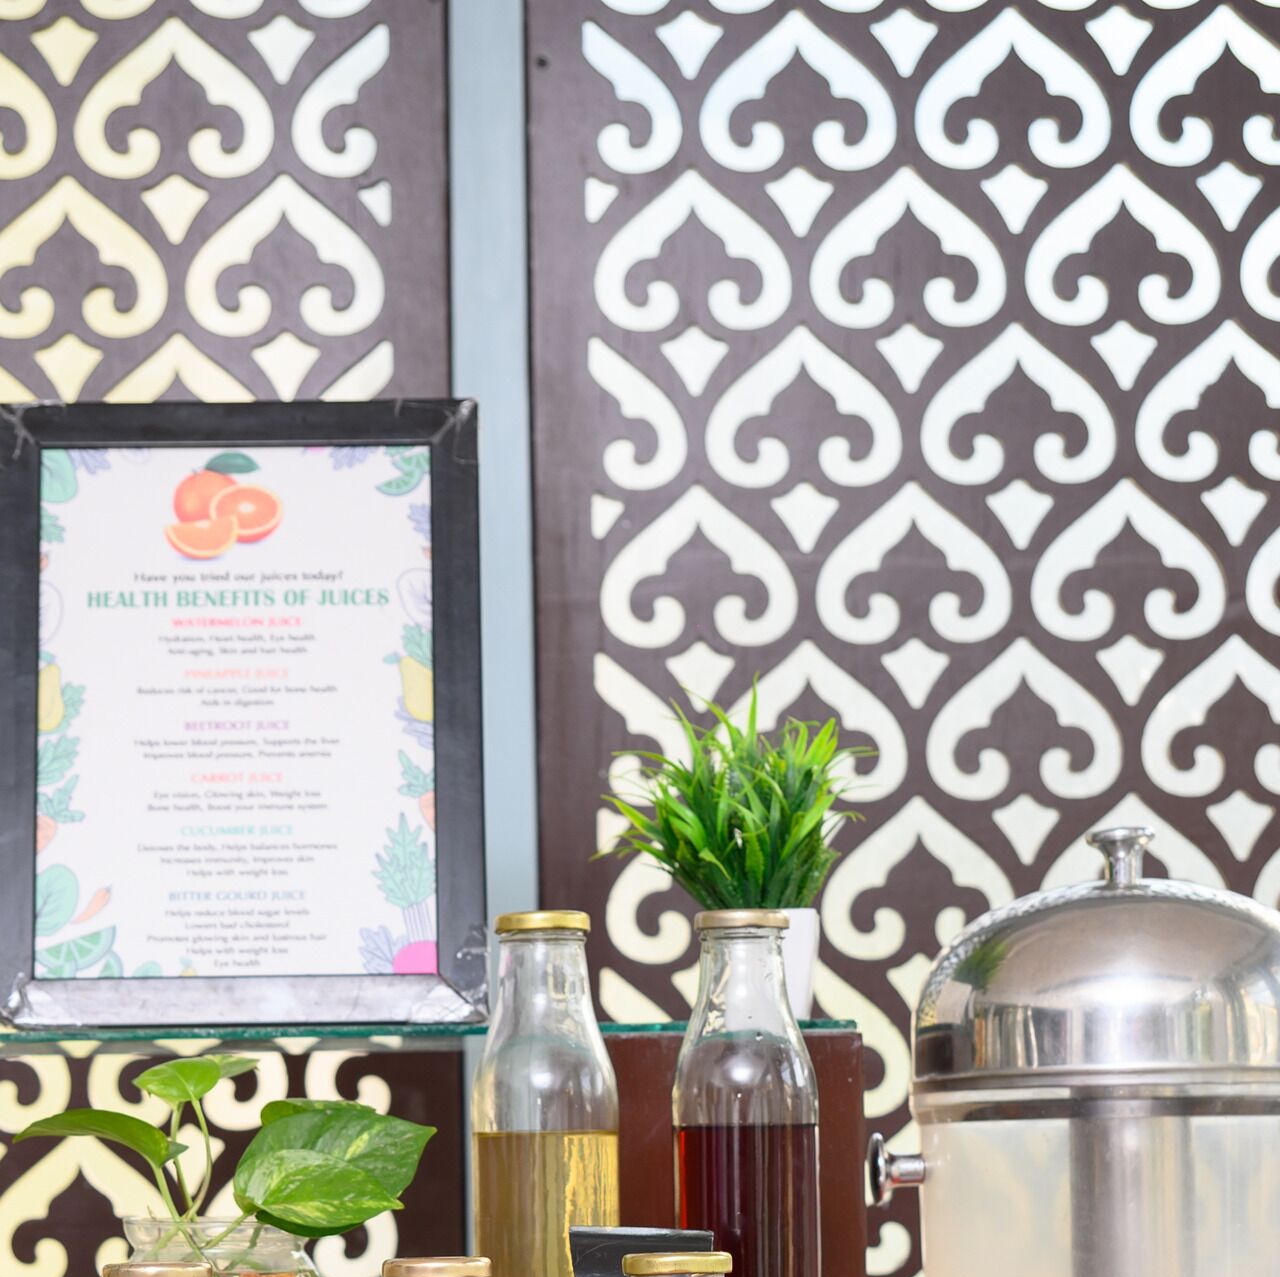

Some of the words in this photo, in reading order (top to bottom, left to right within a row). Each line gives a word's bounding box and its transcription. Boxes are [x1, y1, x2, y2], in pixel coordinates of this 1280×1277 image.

[134, 573, 167, 582] Have
[172, 575, 196, 583] you
[200, 571, 230, 582] tried
[260, 572, 298, 584] juices
[88, 591, 169, 608] HEALTH
[175, 590, 276, 608] BENEFITS
[282, 589, 311, 606] OF
[317, 589, 389, 606] JUICES
[172, 617, 264, 628] WATERMELON
[268, 616, 302, 627] JUICE
[184, 720, 252, 731] BEETROOT
[256, 720, 290, 731] JUICE
[191, 772, 243, 783] CARROT
[248, 771, 284, 784] JUICE
[180, 825, 255, 836] CUCUMBER
[259, 824, 294, 836] JUICE
[169, 891, 212, 901] BITTER
[215, 890, 268, 901] GOURD
[271, 890, 305, 901] JUICE
